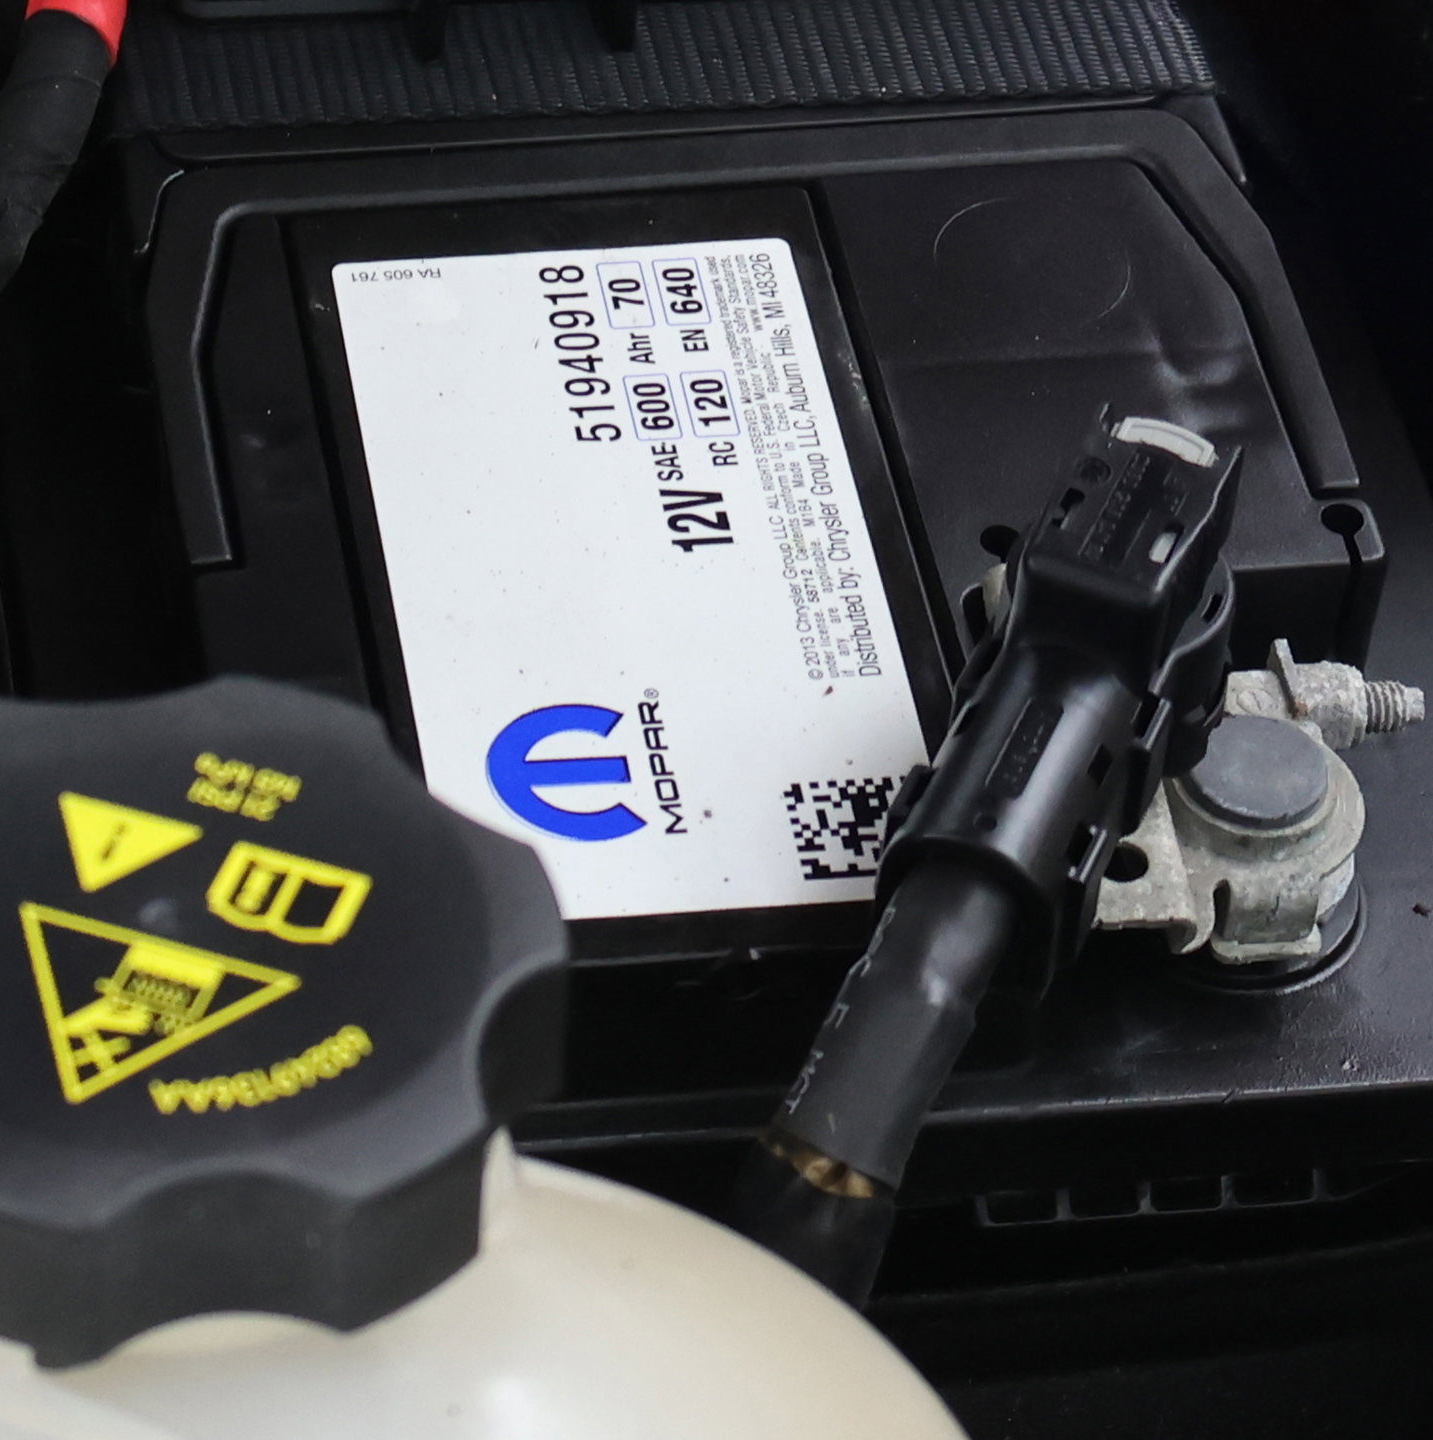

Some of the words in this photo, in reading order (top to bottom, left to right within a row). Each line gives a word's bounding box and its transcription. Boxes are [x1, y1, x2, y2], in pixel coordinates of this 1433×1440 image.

[350, 271, 379, 282] 761
[383, 268, 413, 280] 605
[705, 256, 720, 277] used
[749, 253, 779, 298] 48326
[605, 277, 645, 311] 70
[662, 268, 703, 314] 640
[711, 278, 729, 318] trademark
[735, 255, 763, 331] www.mopar.com
[733, 307, 749, 334] Safety
[762, 301, 786, 319] MI
[540, 264, 622, 443] 51940918
[627, 333, 655, 364] Ahr
[680, 329, 709, 352] EN
[722, 319, 742, 360] registered
[742, 337, 758, 370] Vehicle
[770, 324, 796, 357] Hills,
[751, 374, 766, 401] Motor
[761, 353, 780, 392] Republic
[783, 362, 811, 412] Auburn
[632, 383, 674, 431] 600
[690, 379, 731, 426] 120
[738, 378, 752, 404] Mopar
[759, 403, 777, 436] Federal
[773, 403, 790, 431] Czech
[793, 415, 820, 448] LLC,
[655, 442, 684, 482] SAE
[709, 441, 739, 466] RC
[774, 462, 785, 471] to
[758, 458, 777, 492] RIGHTS
[789, 461, 805, 488] Made
[807, 453, 833, 496] Group
[768, 494, 780, 510] ALL
[780, 475, 797, 514] conform
[659, 488, 734, 554] 12V
[818, 502, 851, 561] Chrysler
[792, 520, 810, 561] Contents
[781, 544, 798, 579] Group
[801, 568, 820, 603] 58712
[837, 567, 861, 590] by:
[789, 583, 811, 633] Chrysler
[827, 608, 841, 624] are
[803, 637, 821, 666] 2013
[835, 638, 850, 657] any
[845, 595, 881, 677] Distributed
[823, 650, 840, 678] under
